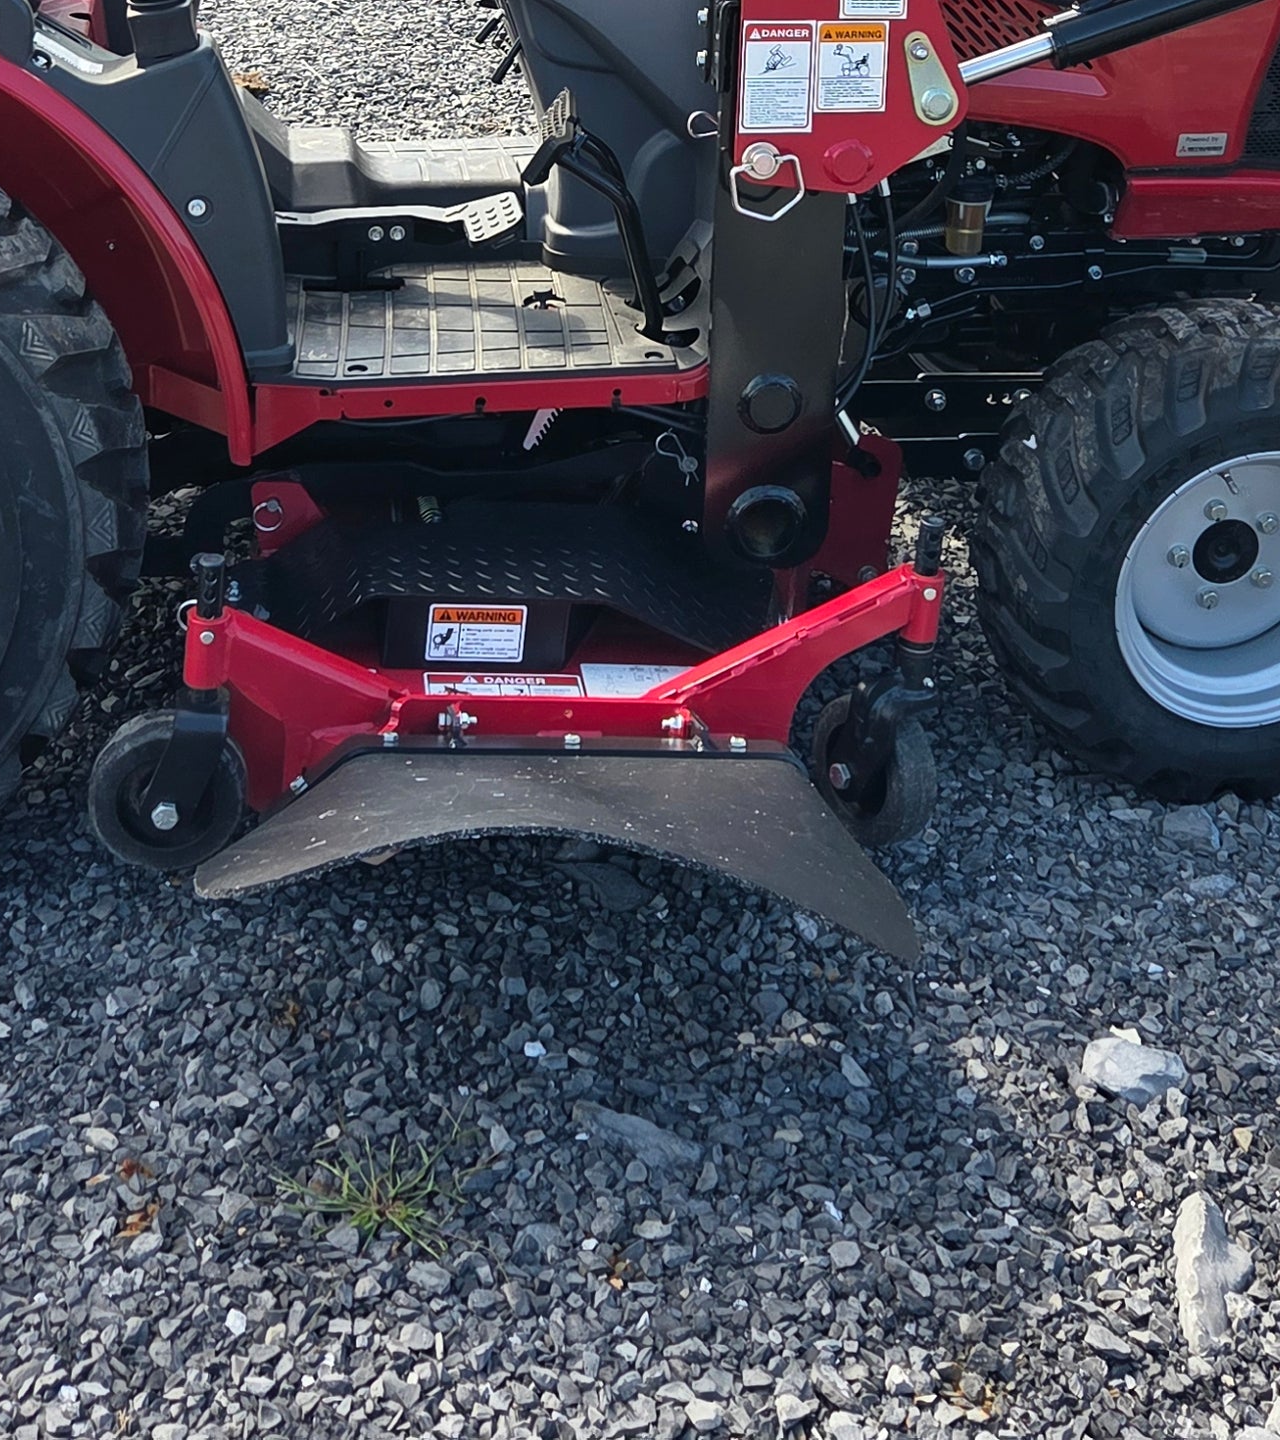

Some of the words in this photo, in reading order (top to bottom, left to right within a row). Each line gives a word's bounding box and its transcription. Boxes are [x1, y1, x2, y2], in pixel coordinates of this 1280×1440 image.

[761, 28, 809, 38] DANGER
[835, 29, 882, 39] WARNING
[456, 611, 516, 622] WARNING
[483, 676, 546, 685] DANGER
